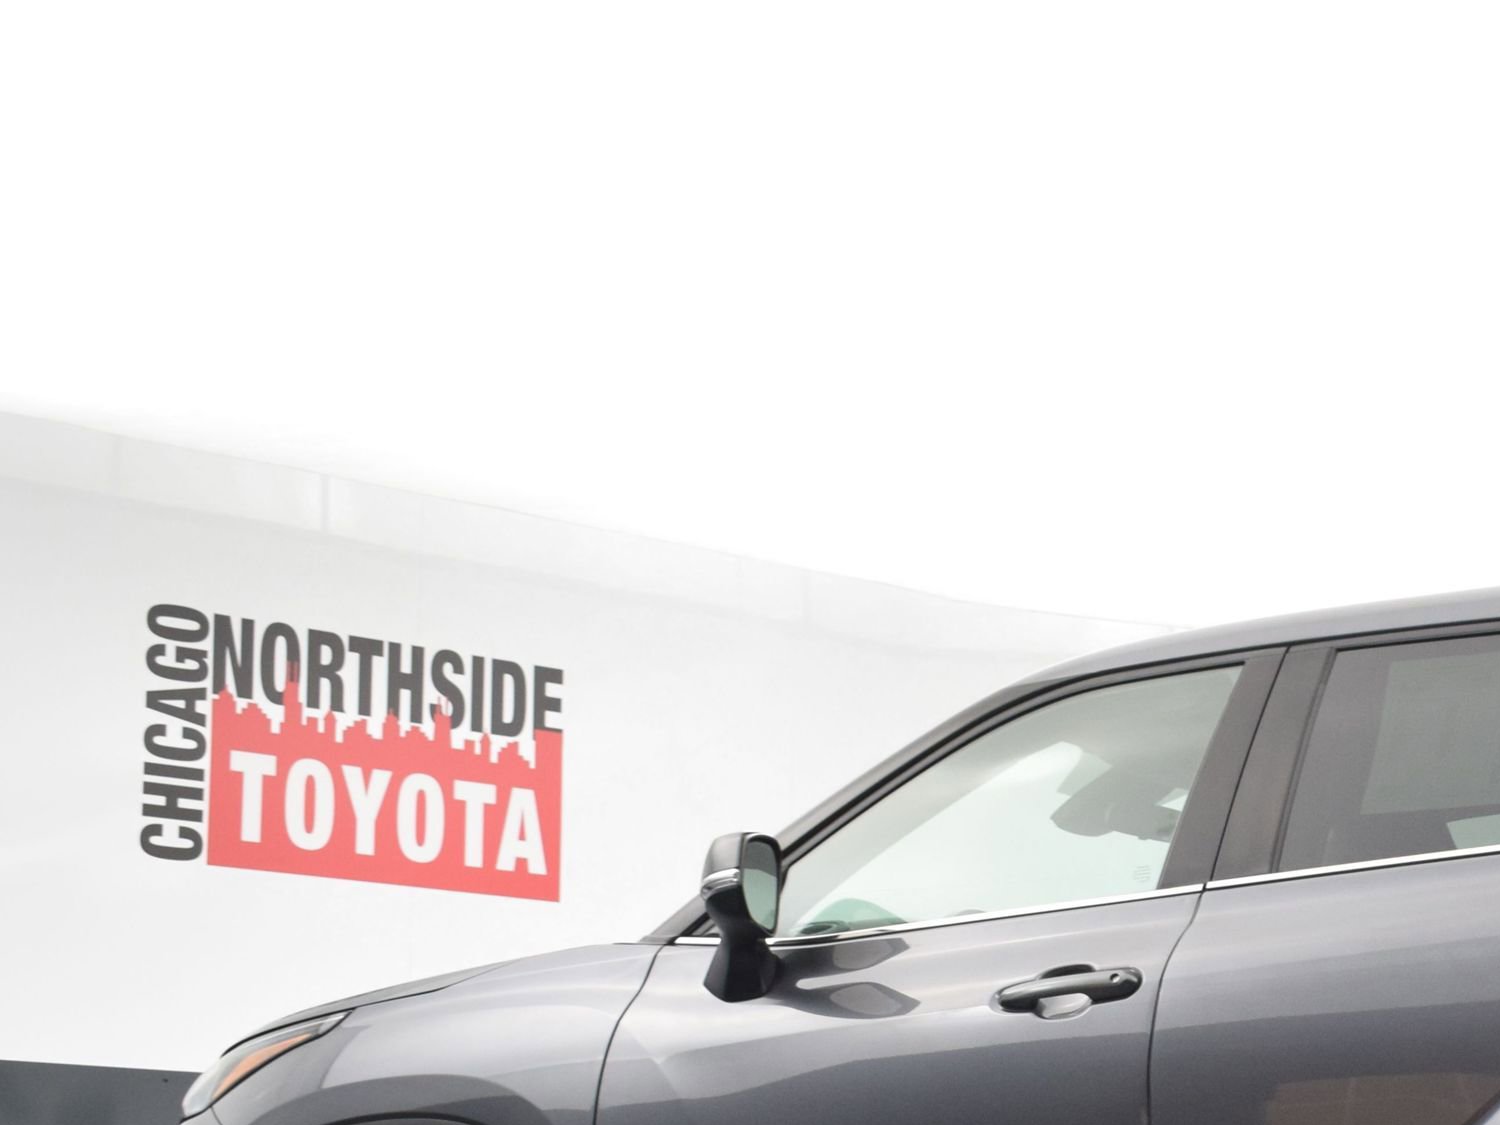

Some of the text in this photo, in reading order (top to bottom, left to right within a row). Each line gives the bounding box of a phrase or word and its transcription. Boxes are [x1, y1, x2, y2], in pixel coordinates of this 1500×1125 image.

[140, 603, 210, 862] CHICAGO
[212, 612, 564, 738] NORTHSIDE
[229, 749, 548, 876] TOYOTA
